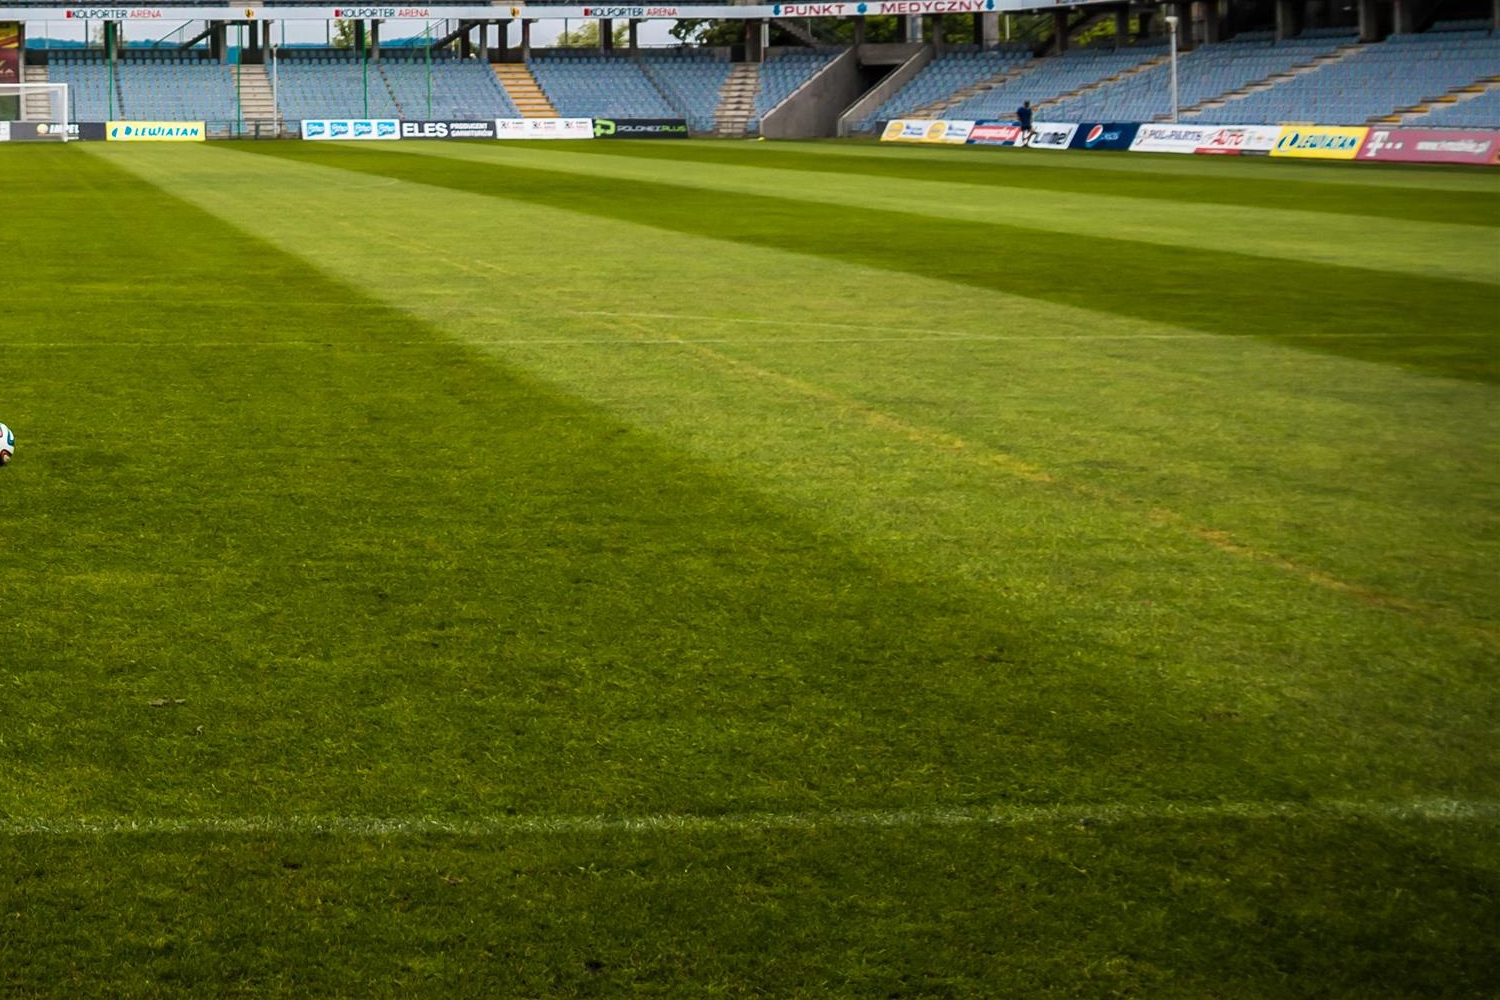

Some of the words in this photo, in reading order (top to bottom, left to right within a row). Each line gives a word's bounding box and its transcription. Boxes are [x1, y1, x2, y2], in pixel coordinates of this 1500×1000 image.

[589, 8, 644, 17] KOLPORTER
[646, 8, 678, 17] ARENA
[784, 4, 845, 16] PUNKT
[880, 0, 985, 14] MEDYCZNY
[72, 10, 128, 18] KOLPORTER
[130, 10, 162, 18] ARENA
[341, 9, 395, 17] KOLPORTER
[398, 9, 430, 17] ARENA
[134, 127, 199, 137] LEWIATAN
[402, 122, 448, 137] ELES
